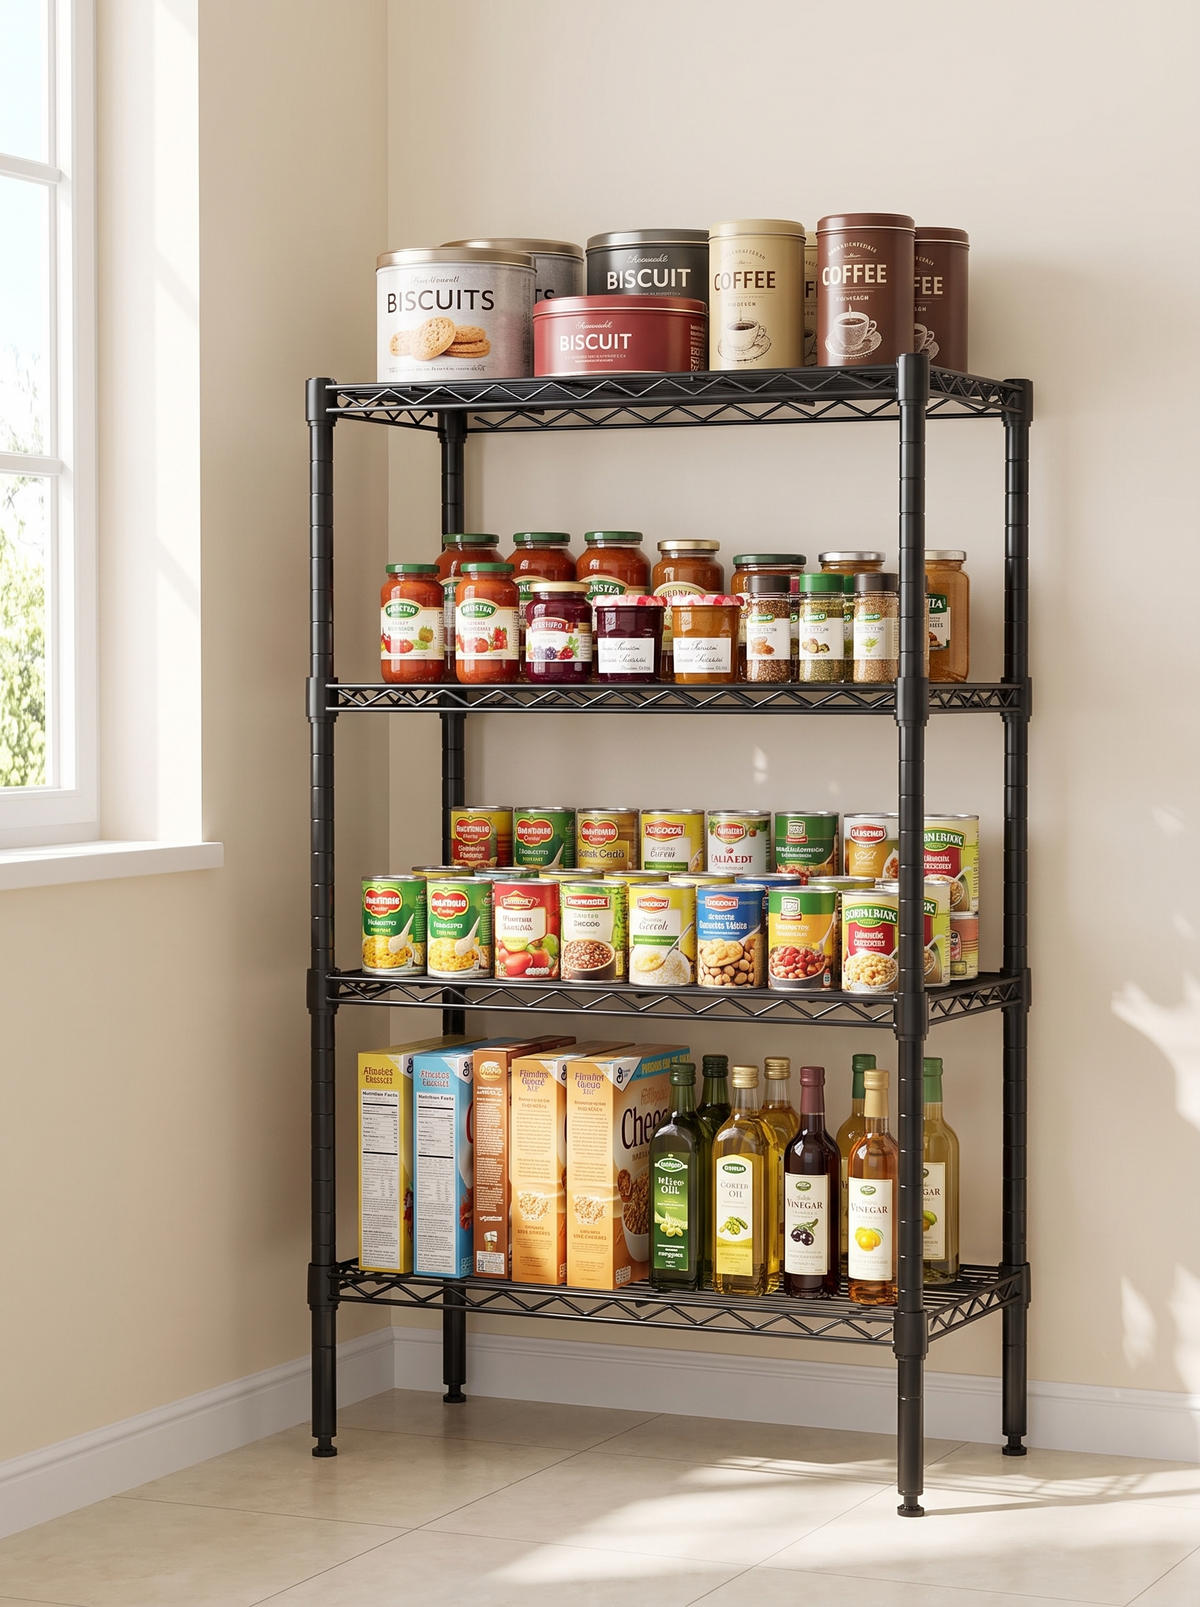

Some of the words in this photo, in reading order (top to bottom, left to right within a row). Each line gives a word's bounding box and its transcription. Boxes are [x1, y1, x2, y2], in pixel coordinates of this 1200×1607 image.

[607, 268, 691, 290] BISCUIT
[714, 270, 776, 292] COFFEE
[822, 264, 887, 287] COFFEE
[387, 289, 495, 313] BISCUITS
[559, 333, 632, 351] BISCUIT
[923, 1188, 941, 1196] GAR
[787, 1197, 823, 1209] VINEGAR
[850, 1202, 888, 1214] VINEGAR
